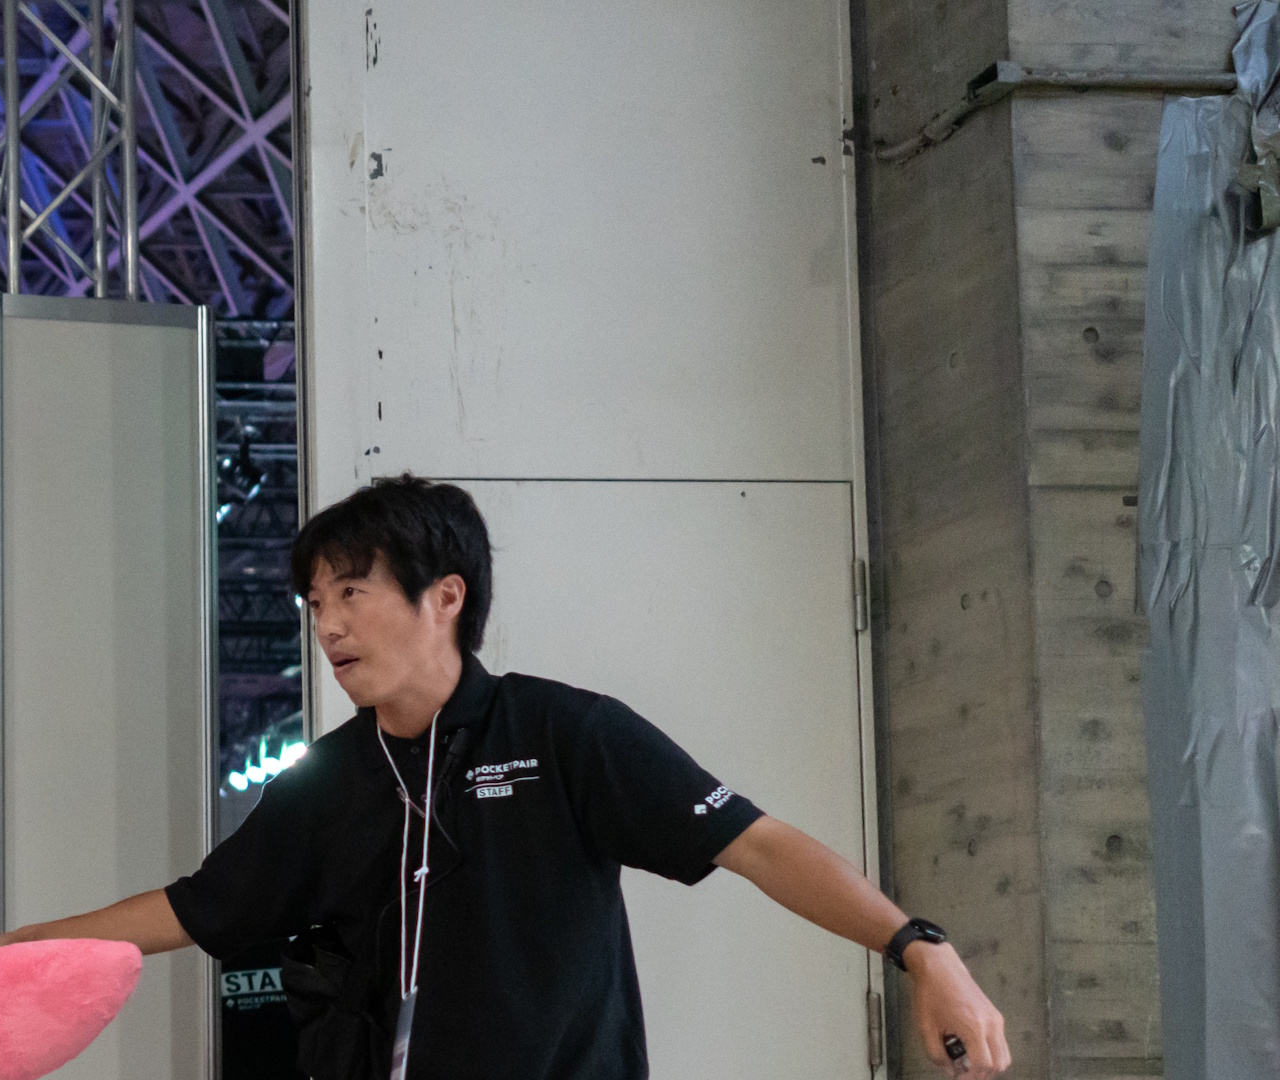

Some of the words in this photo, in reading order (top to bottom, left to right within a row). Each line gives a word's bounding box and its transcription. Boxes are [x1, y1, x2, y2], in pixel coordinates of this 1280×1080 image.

[475, 759, 538, 775] POCKETPAIR
[478, 786, 512, 798] STAFF
[224, 969, 283, 994] STA
